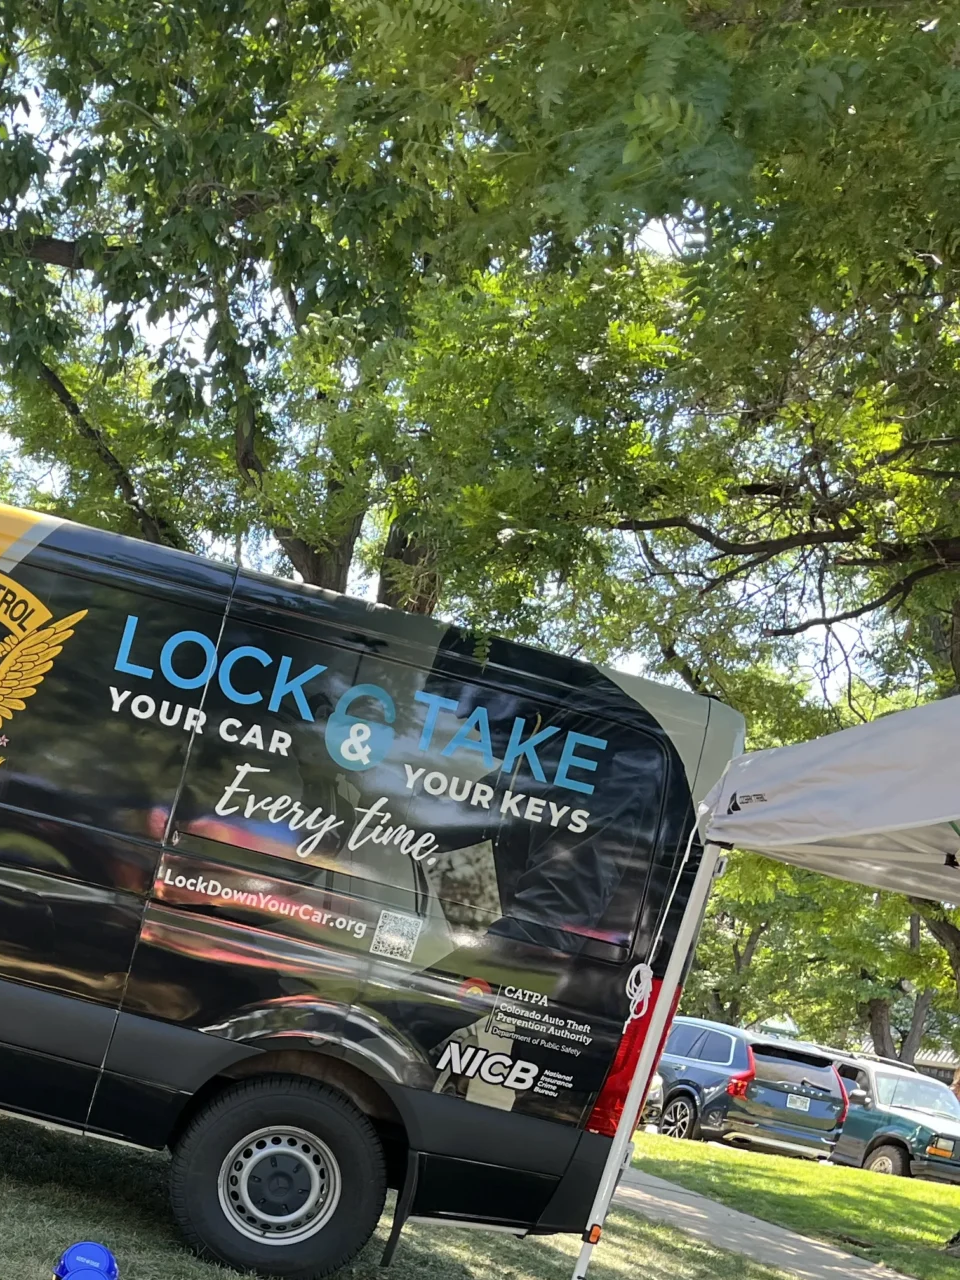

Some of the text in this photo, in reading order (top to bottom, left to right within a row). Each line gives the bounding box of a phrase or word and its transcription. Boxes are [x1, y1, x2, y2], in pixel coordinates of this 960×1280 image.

[114, 615, 608, 795] LOCK & TAKE
[108, 686, 293, 757] YOUR CAR
[214, 763, 440, 866] Every time.
[404, 764, 591, 834] YOUR KEYS
[164, 868, 368, 939] LockDownYourCar.org
[504, 985, 548, 1007] CATPA
[496, 1012, 592, 1046] Prevention Authority
[500, 1003, 591, 1033] Colorado Auto Theft
[493, 1027, 531, 1043] Department
[540, 1039, 560, 1051] Public
[561, 1045, 581, 1057] Safety
[436, 1042, 539, 1090] NICB
[540, 1075, 573, 1088] Insurance
[544, 1069, 573, 1081] National
[534, 1086, 558, 1097] Bureau
[537, 1081, 557, 1090] Crime
